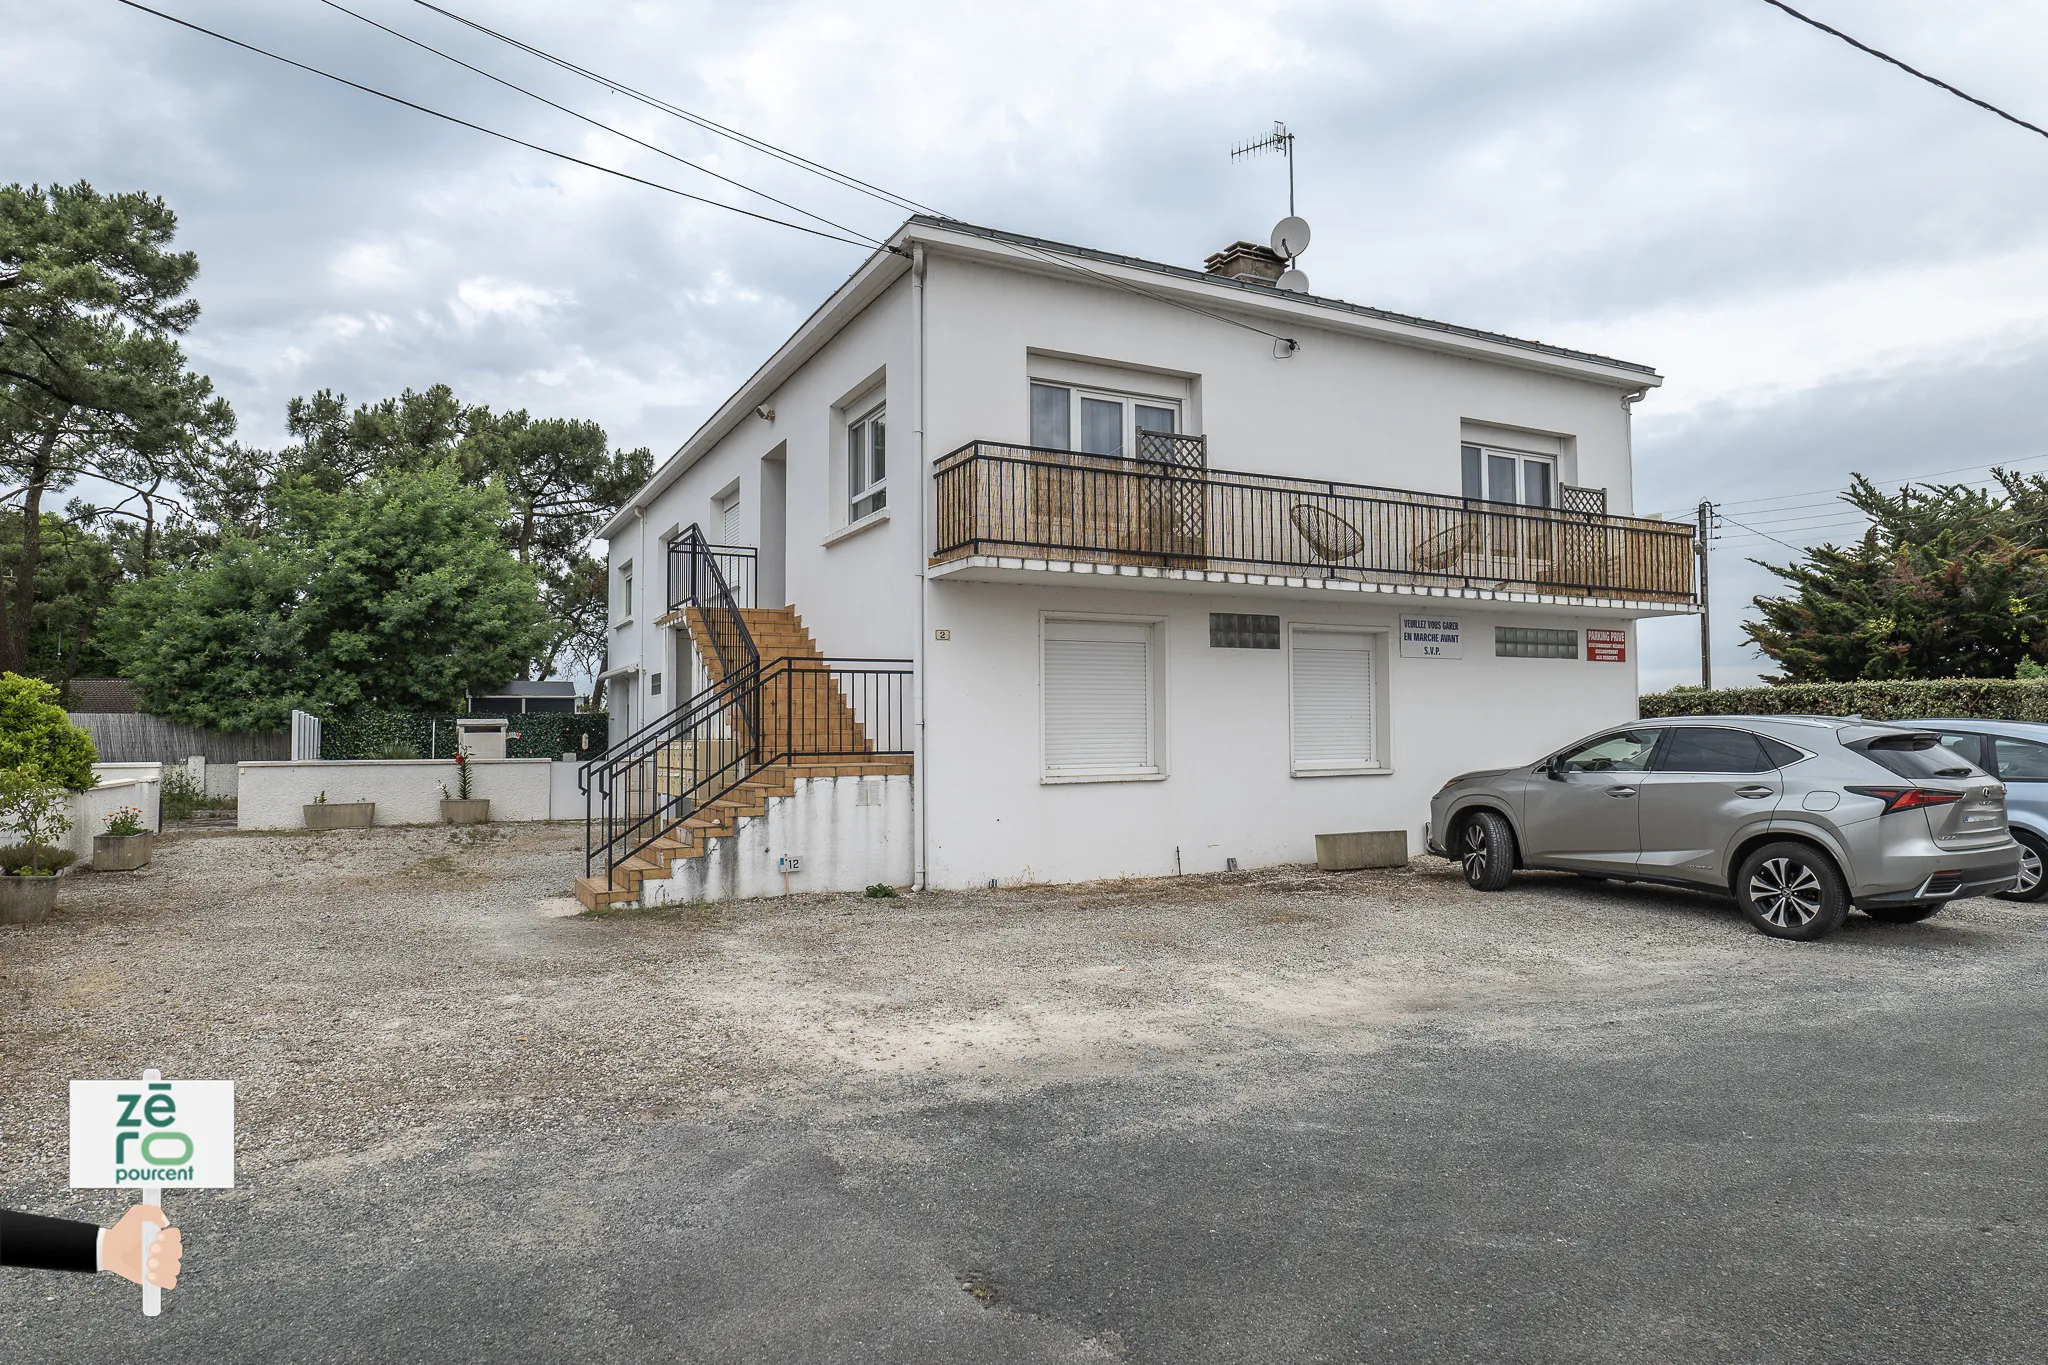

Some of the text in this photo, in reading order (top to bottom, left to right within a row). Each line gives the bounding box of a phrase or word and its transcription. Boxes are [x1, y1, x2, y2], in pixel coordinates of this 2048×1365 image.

[1404, 619, 1459, 630] VEUILLEZ VOUS GARER
[939, 631, 946, 639] 2
[1404, 632, 1459, 643] EN MARCHE AVANT
[1588, 631, 1609, 641] PARKING
[1424, 646, 1441, 656] S.V.P.
[788, 859, 799, 869] 12
